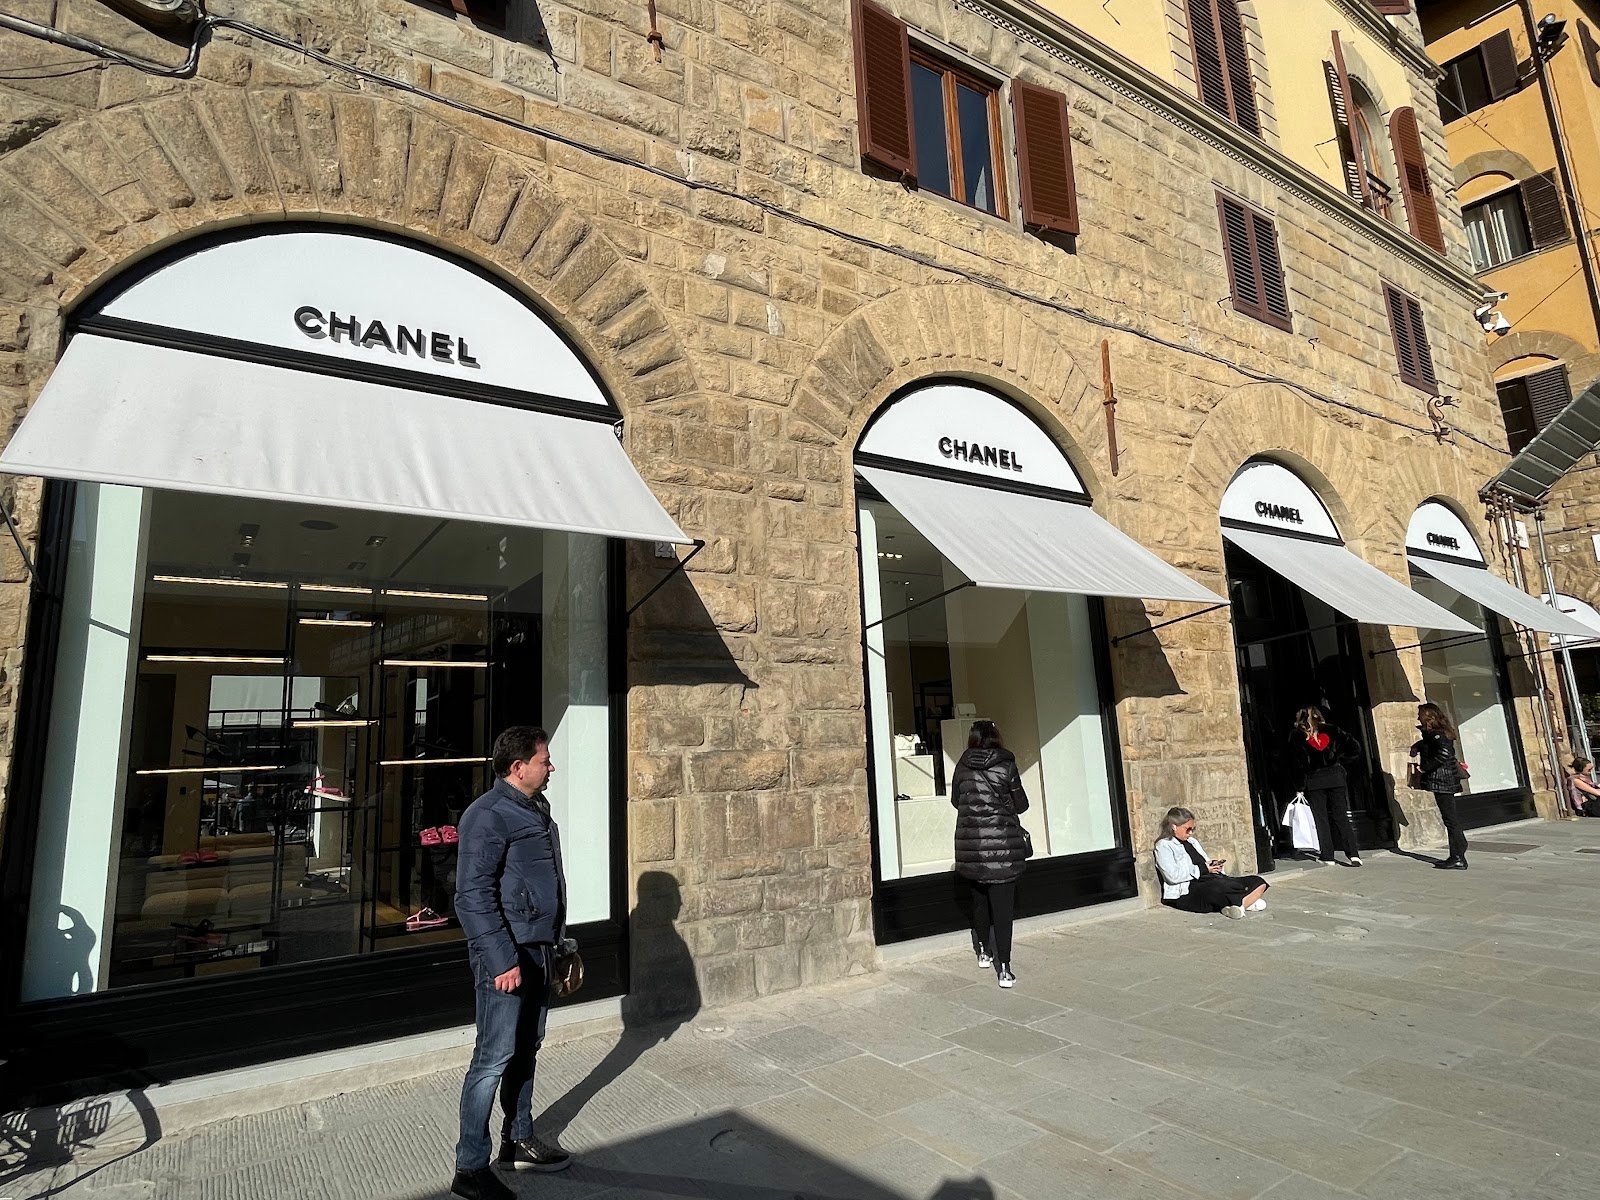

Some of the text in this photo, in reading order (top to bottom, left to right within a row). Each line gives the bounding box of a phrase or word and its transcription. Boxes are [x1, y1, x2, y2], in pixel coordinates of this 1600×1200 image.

[294, 305, 481, 369] CHANEL
[938, 436, 1023, 473] CHANEL
[1255, 500, 1304, 525] CHANEL
